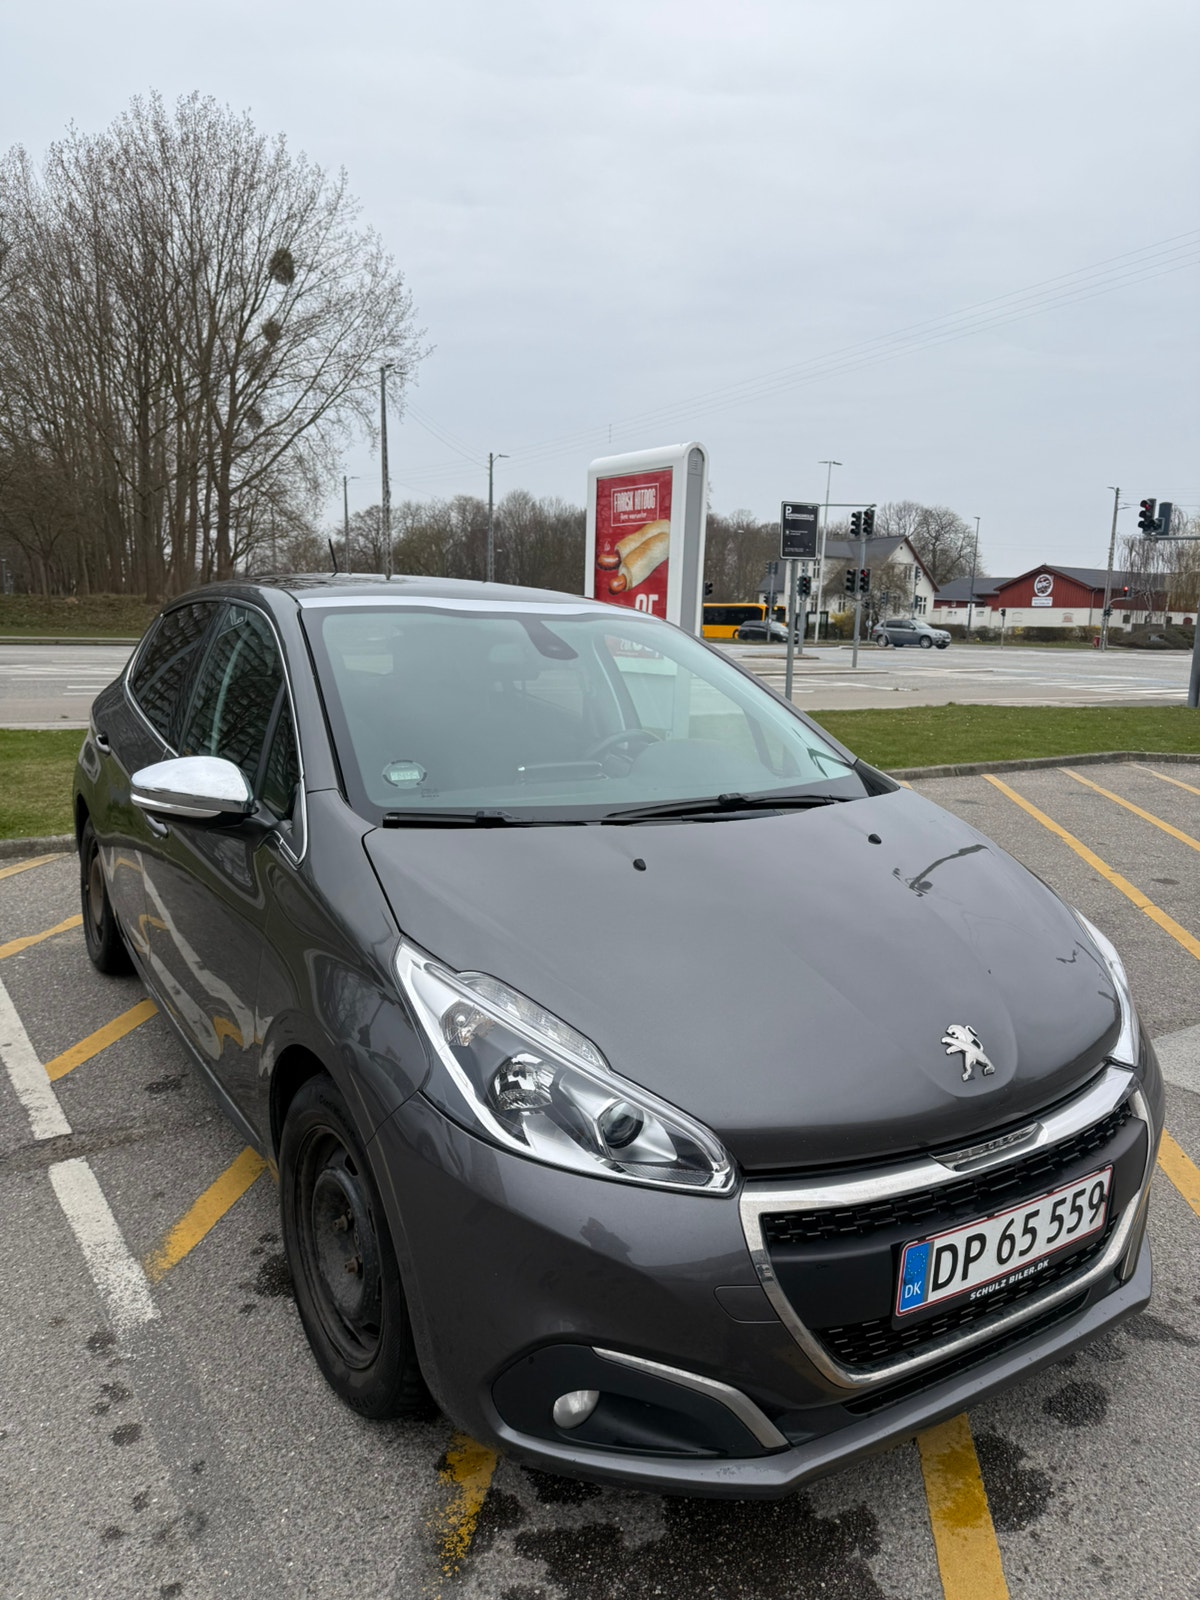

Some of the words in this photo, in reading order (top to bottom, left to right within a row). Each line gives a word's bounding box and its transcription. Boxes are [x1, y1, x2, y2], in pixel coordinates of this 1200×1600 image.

[931, 1232, 987, 1293] DP
[996, 1209, 1040, 1266] 65
[1046, 1180, 1105, 1244] 559
[904, 1280, 922, 1299] DK
[970, 1279, 1007, 1301] SCHULZ
[1008, 1259, 1050, 1284] BILER.DK
